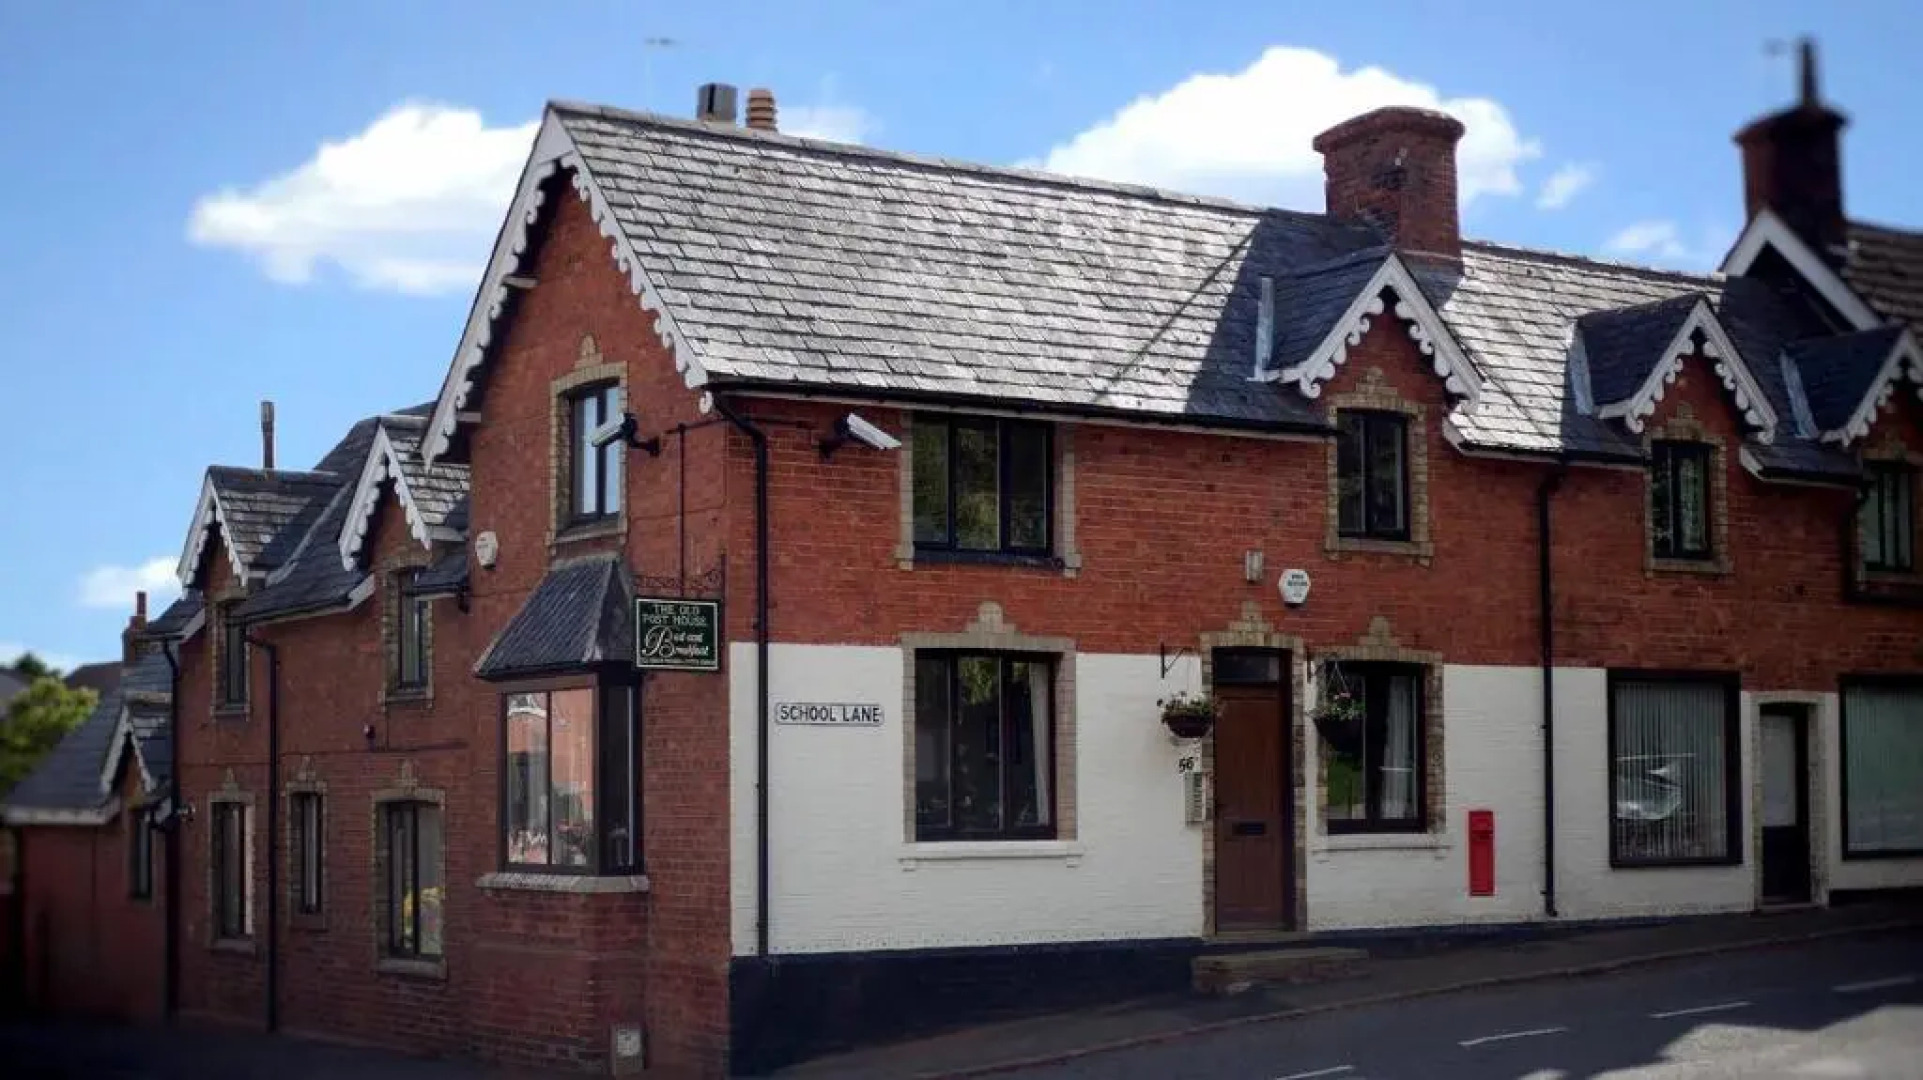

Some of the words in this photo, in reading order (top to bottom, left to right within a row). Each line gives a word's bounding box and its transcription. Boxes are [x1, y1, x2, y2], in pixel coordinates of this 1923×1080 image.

[654, 604, 675, 615] THE
[680, 606, 700, 615] OLD
[642, 613, 669, 624] POST
[780, 705, 836, 722] SCHOOL
[843, 706, 880, 722] LANE
[1178, 756, 1194, 774] 56
